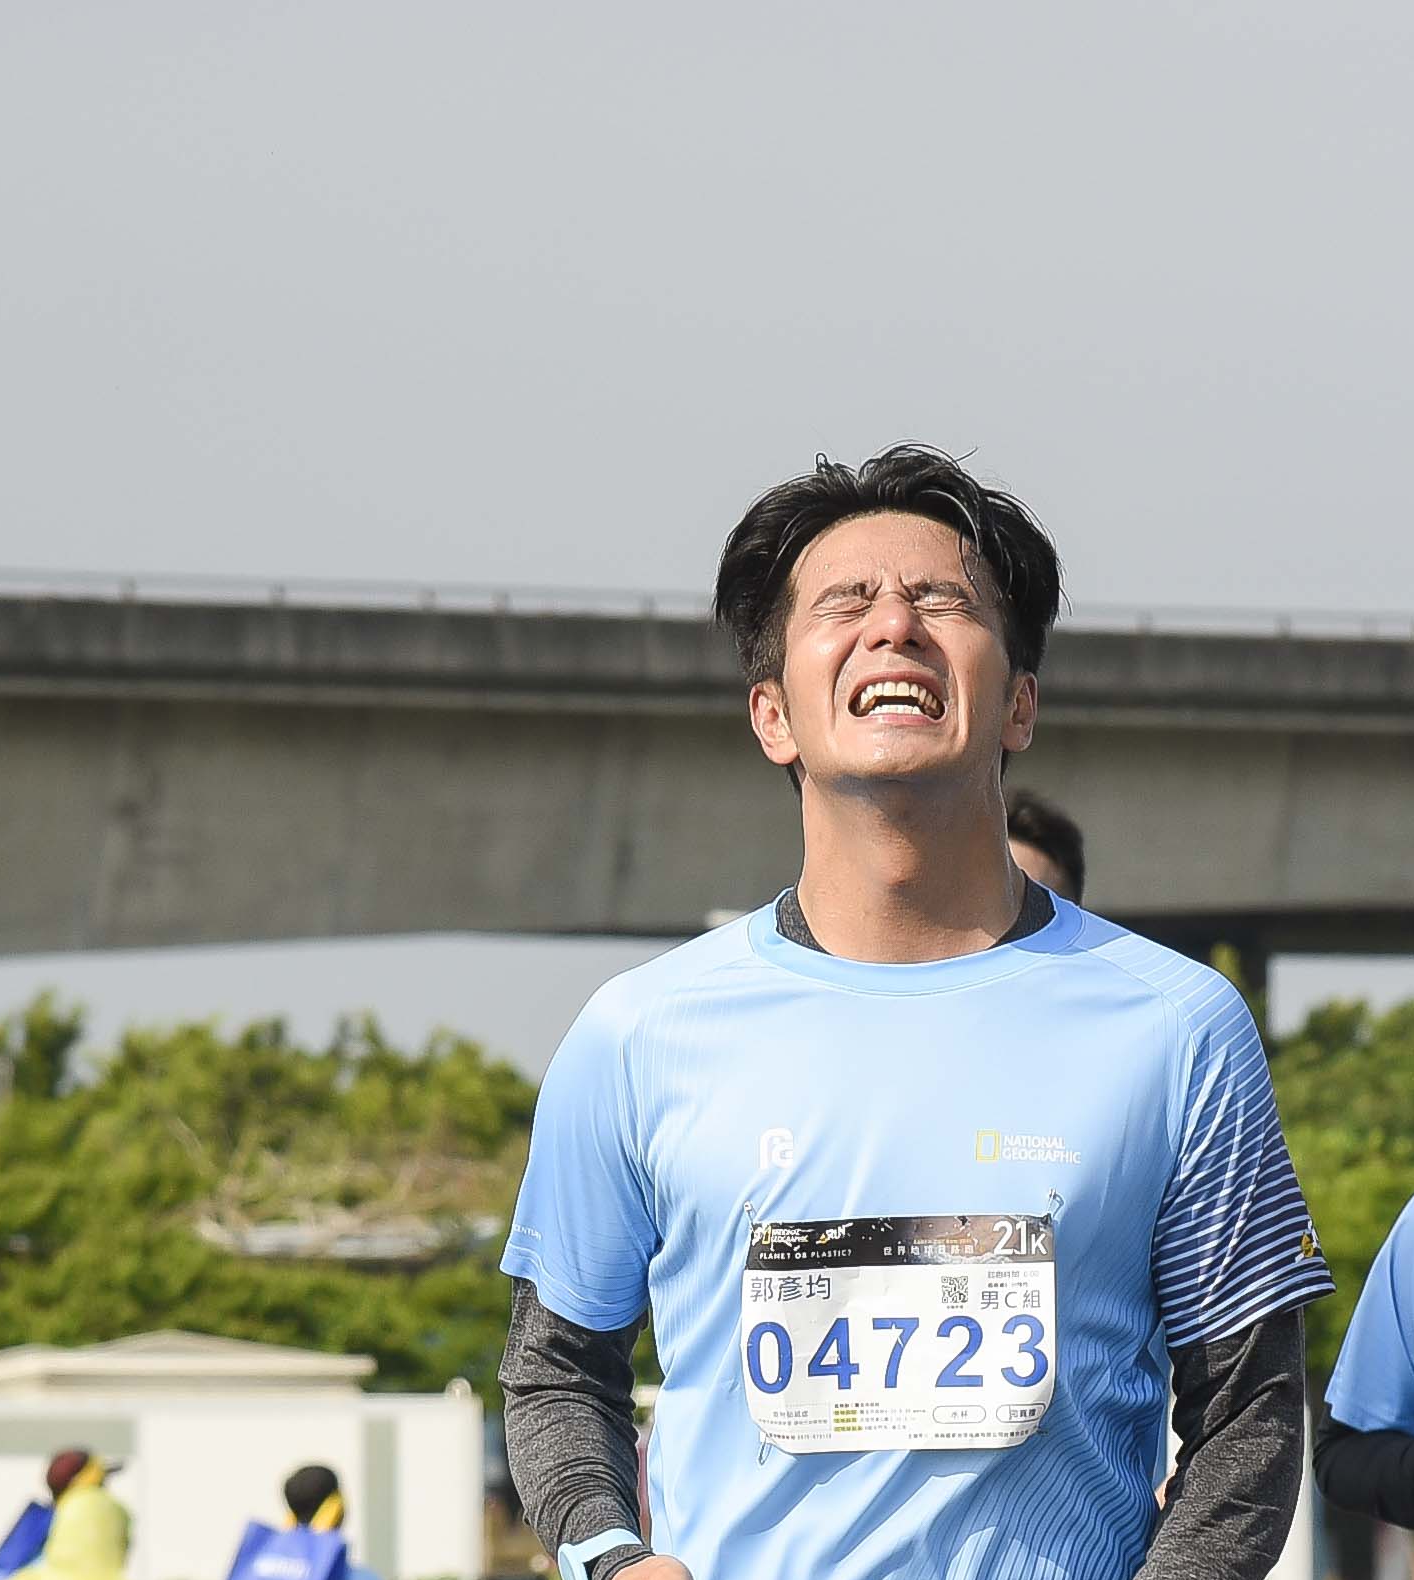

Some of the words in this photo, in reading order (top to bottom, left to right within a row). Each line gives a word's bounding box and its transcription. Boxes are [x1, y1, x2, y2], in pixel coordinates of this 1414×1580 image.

[1003, 1135, 1066, 1150] NATIONAL
[1002, 1147, 1082, 1165] GEOGRAPHIC
[750, 1273, 832, 1303] 郭彥均
[746, 1314, 1049, 1394] 04723
